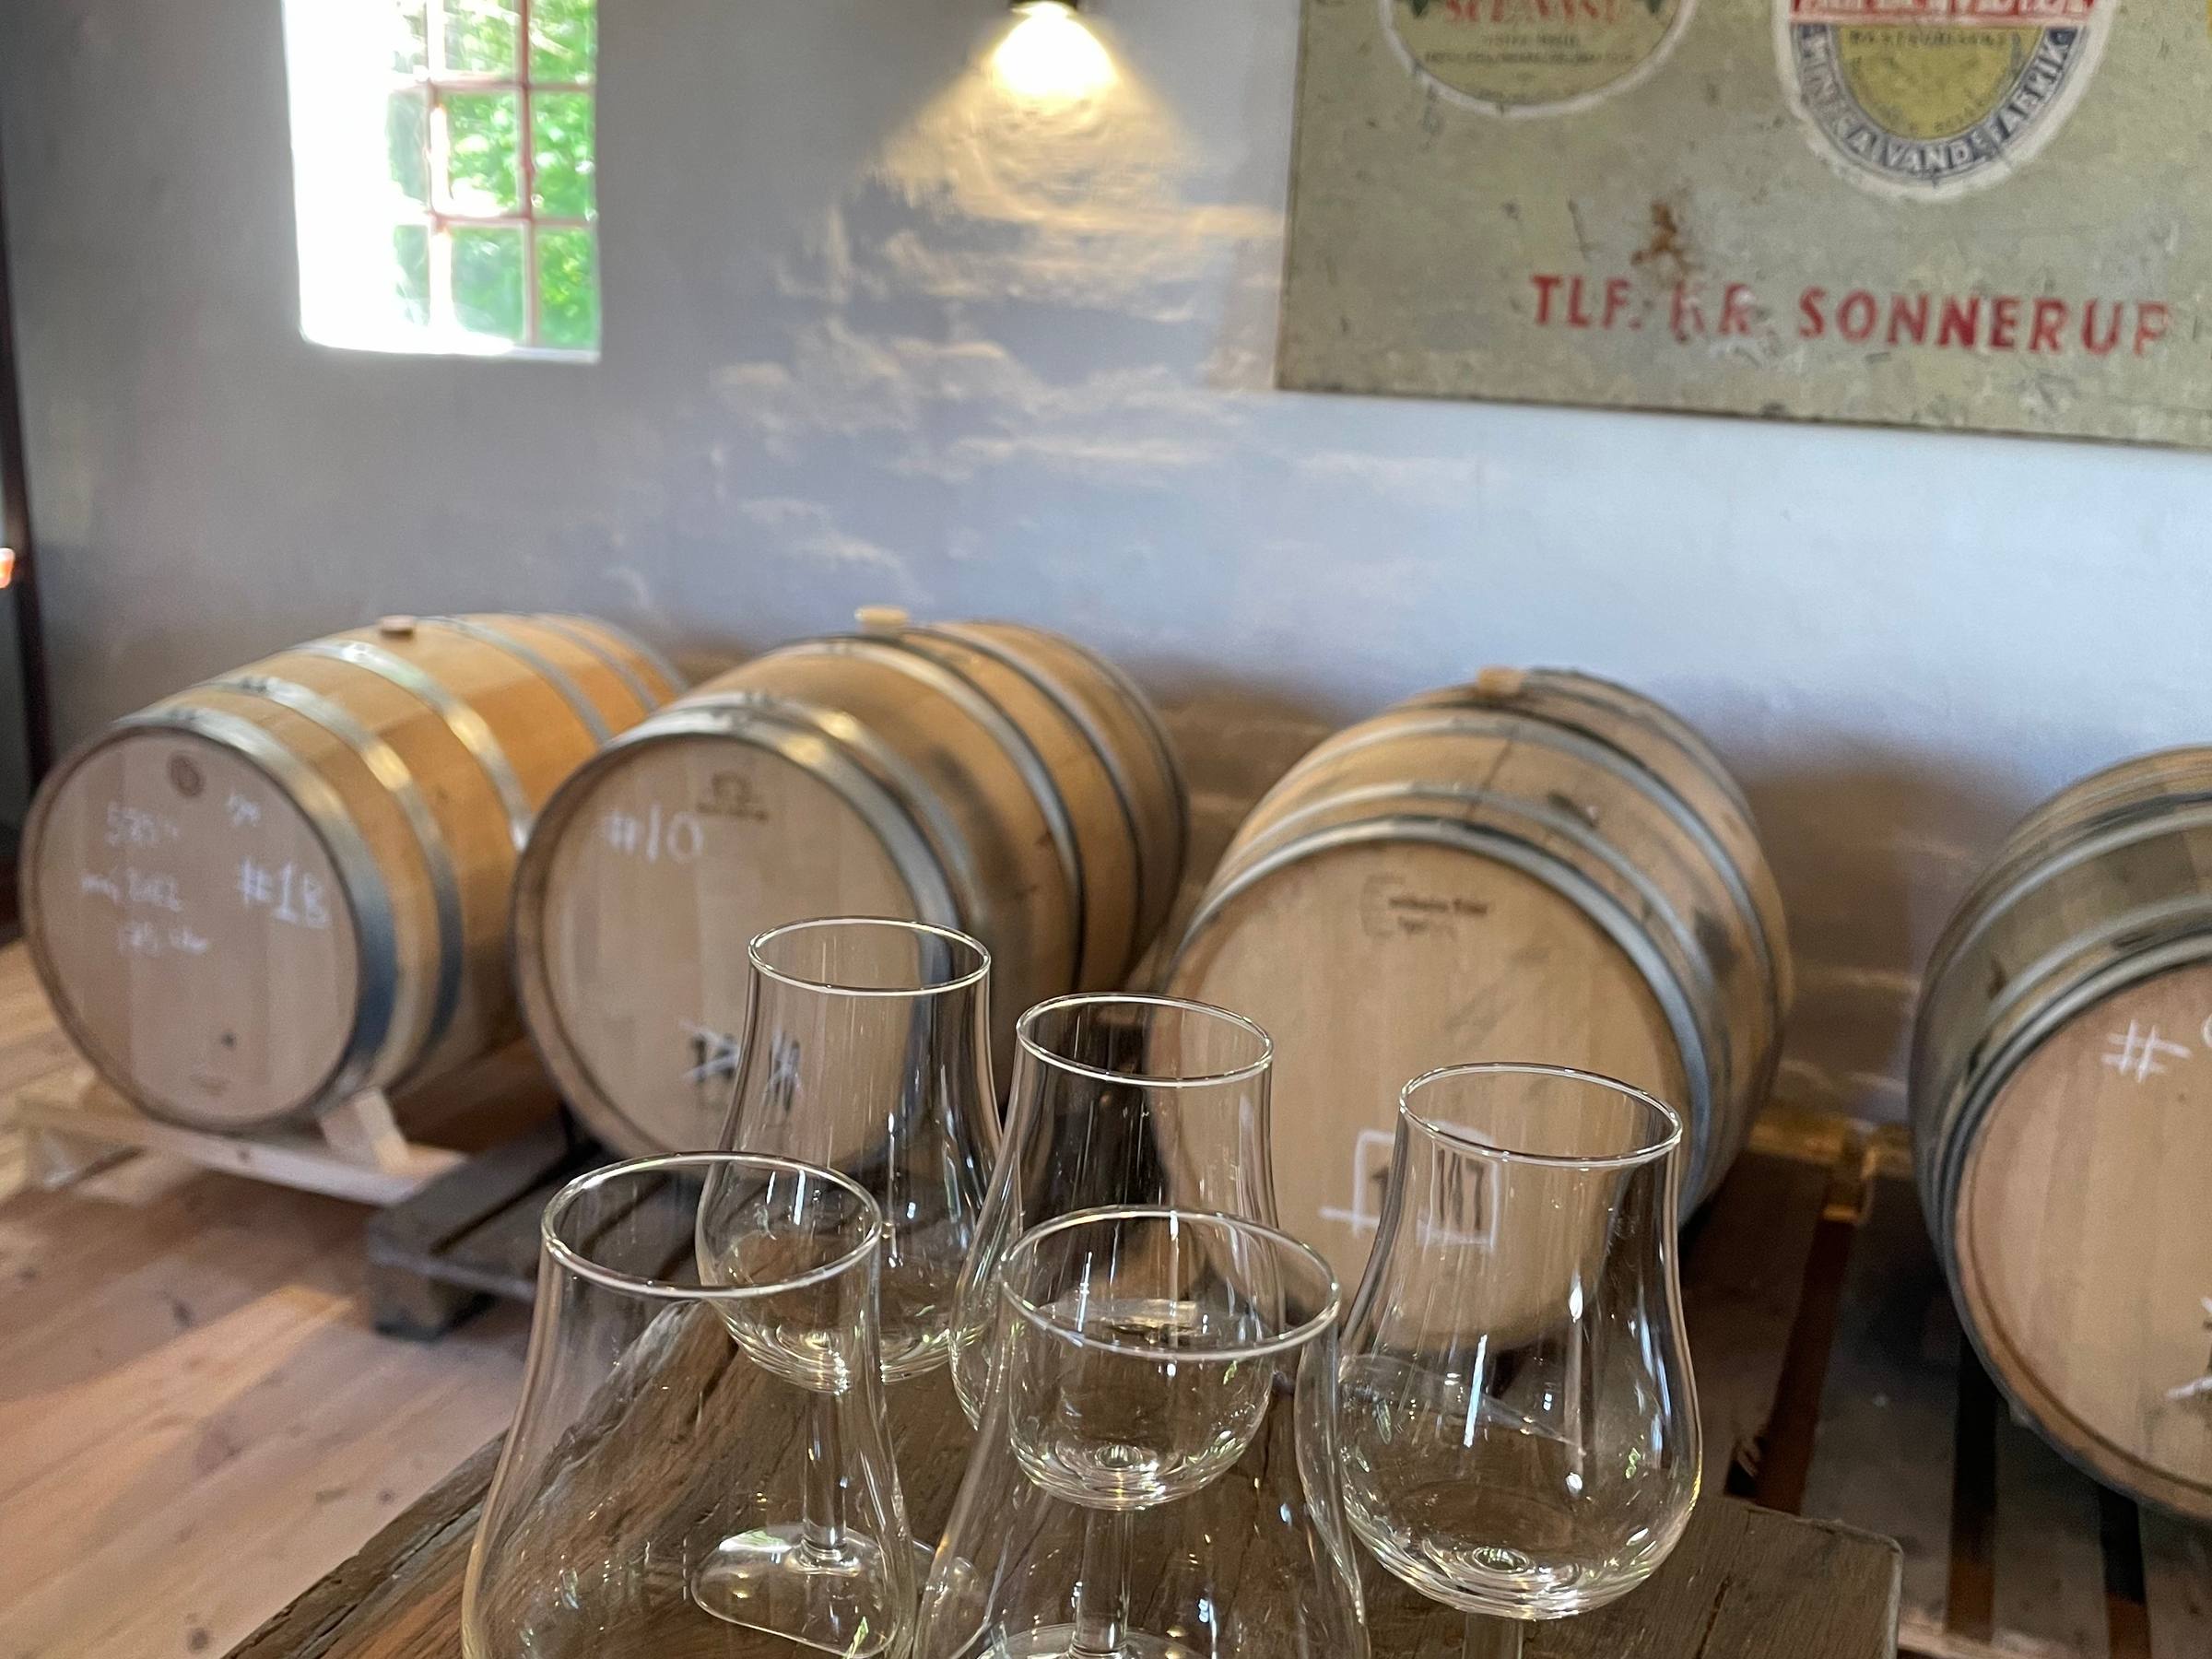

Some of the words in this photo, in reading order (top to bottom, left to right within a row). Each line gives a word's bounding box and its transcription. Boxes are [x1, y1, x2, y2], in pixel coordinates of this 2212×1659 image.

[1530, 275, 1643, 330] TLF.
[1798, 285, 2172, 356] SONNERUP
[599, 804, 704, 865] #10
